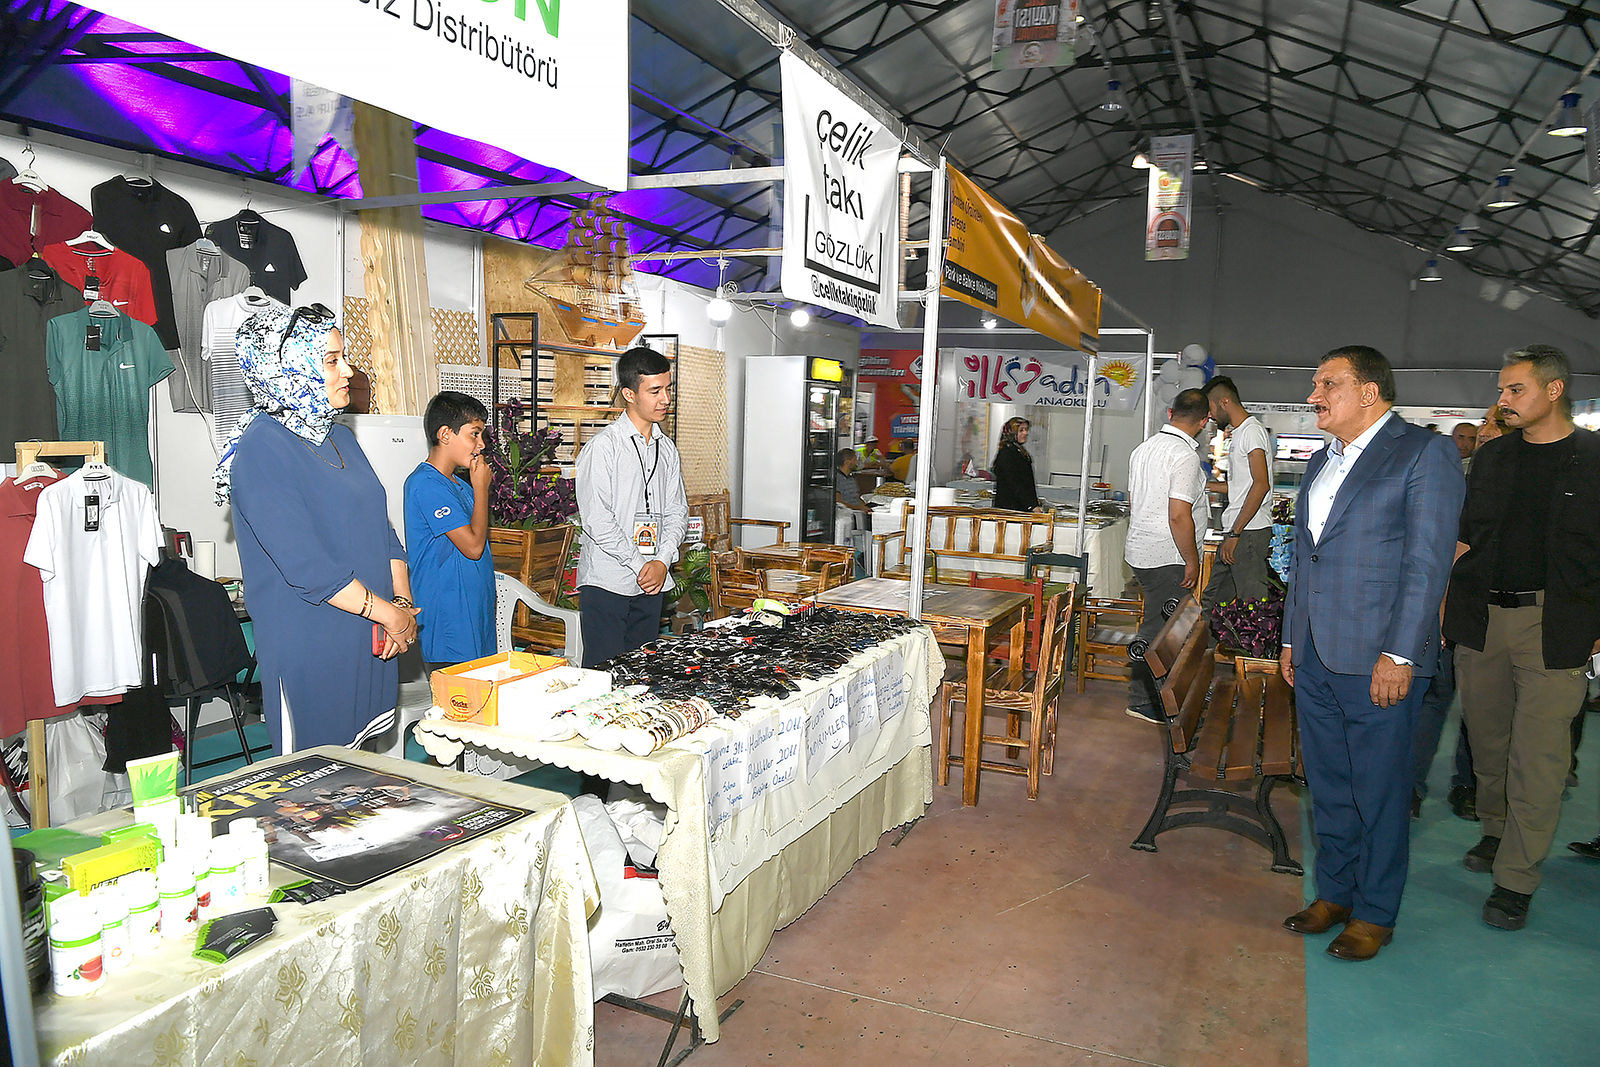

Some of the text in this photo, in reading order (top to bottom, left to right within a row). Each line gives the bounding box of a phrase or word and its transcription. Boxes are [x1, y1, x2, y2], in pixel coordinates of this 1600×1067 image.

[413, 0, 558, 89] Distribütörü
[816, 109, 874, 170] çelik
[823, 163, 864, 220] takı
[814, 231, 874, 274] GÖZLÜK
[287, 762, 346, 788] DEMEK
